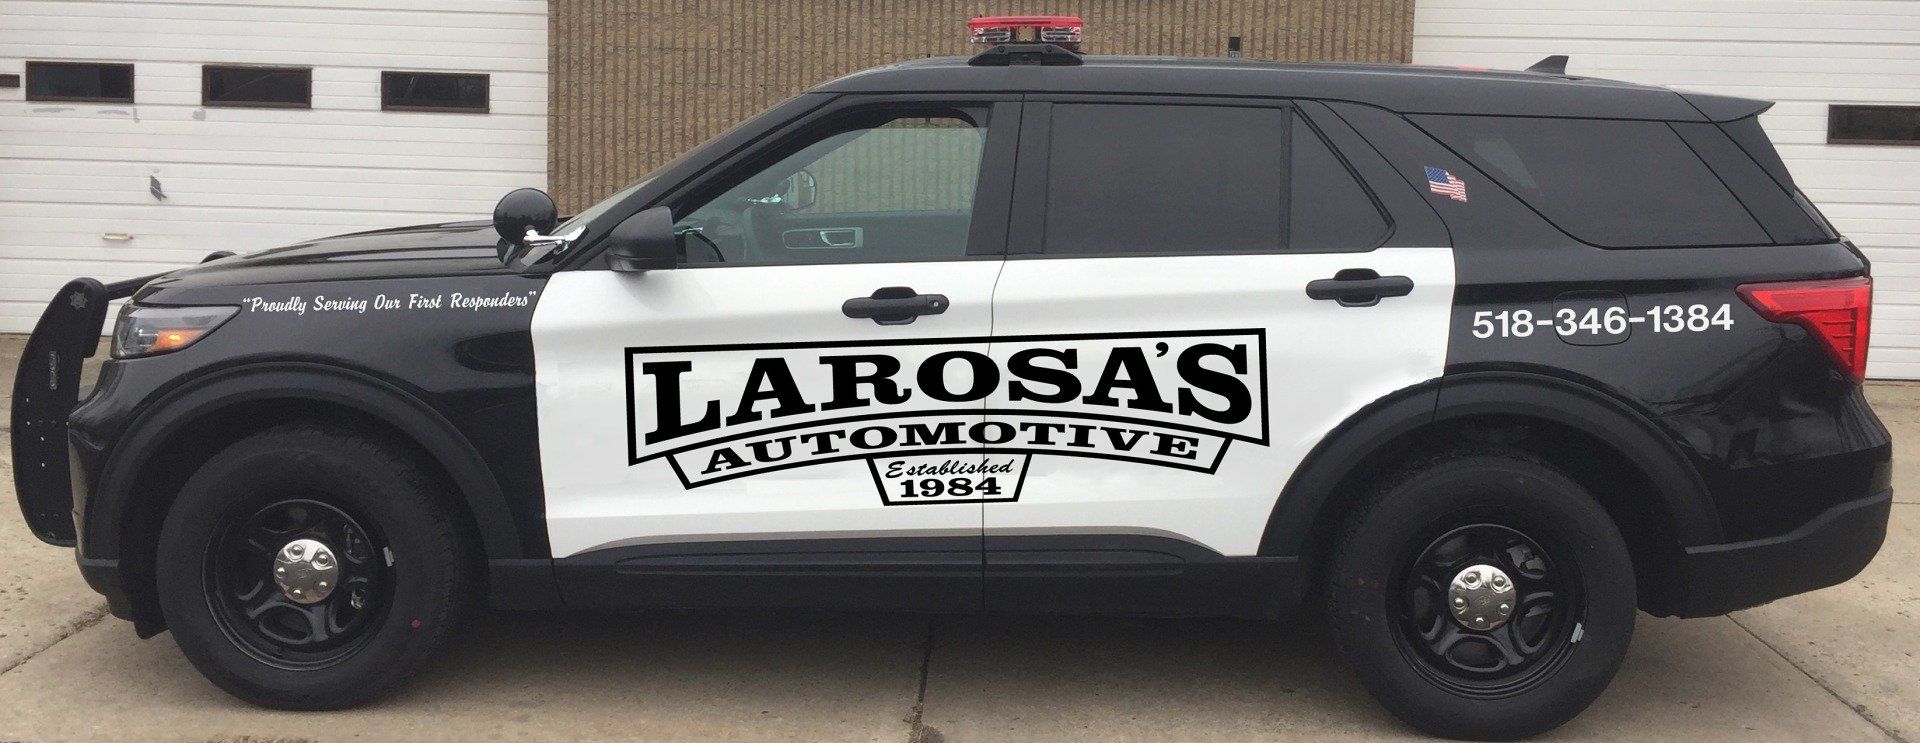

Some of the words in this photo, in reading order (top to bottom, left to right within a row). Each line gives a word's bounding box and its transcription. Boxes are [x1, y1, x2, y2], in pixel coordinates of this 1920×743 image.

[313, 295, 368, 314] Serving
[374, 293, 402, 310] Our
[408, 292, 443, 310] First
[1472, 303, 1735, 339] 518-346-1384
[700, 421, 1200, 475] AUTOMOTIVE
[884, 457, 1015, 482] Established
[900, 476, 1003, 499] 1984
